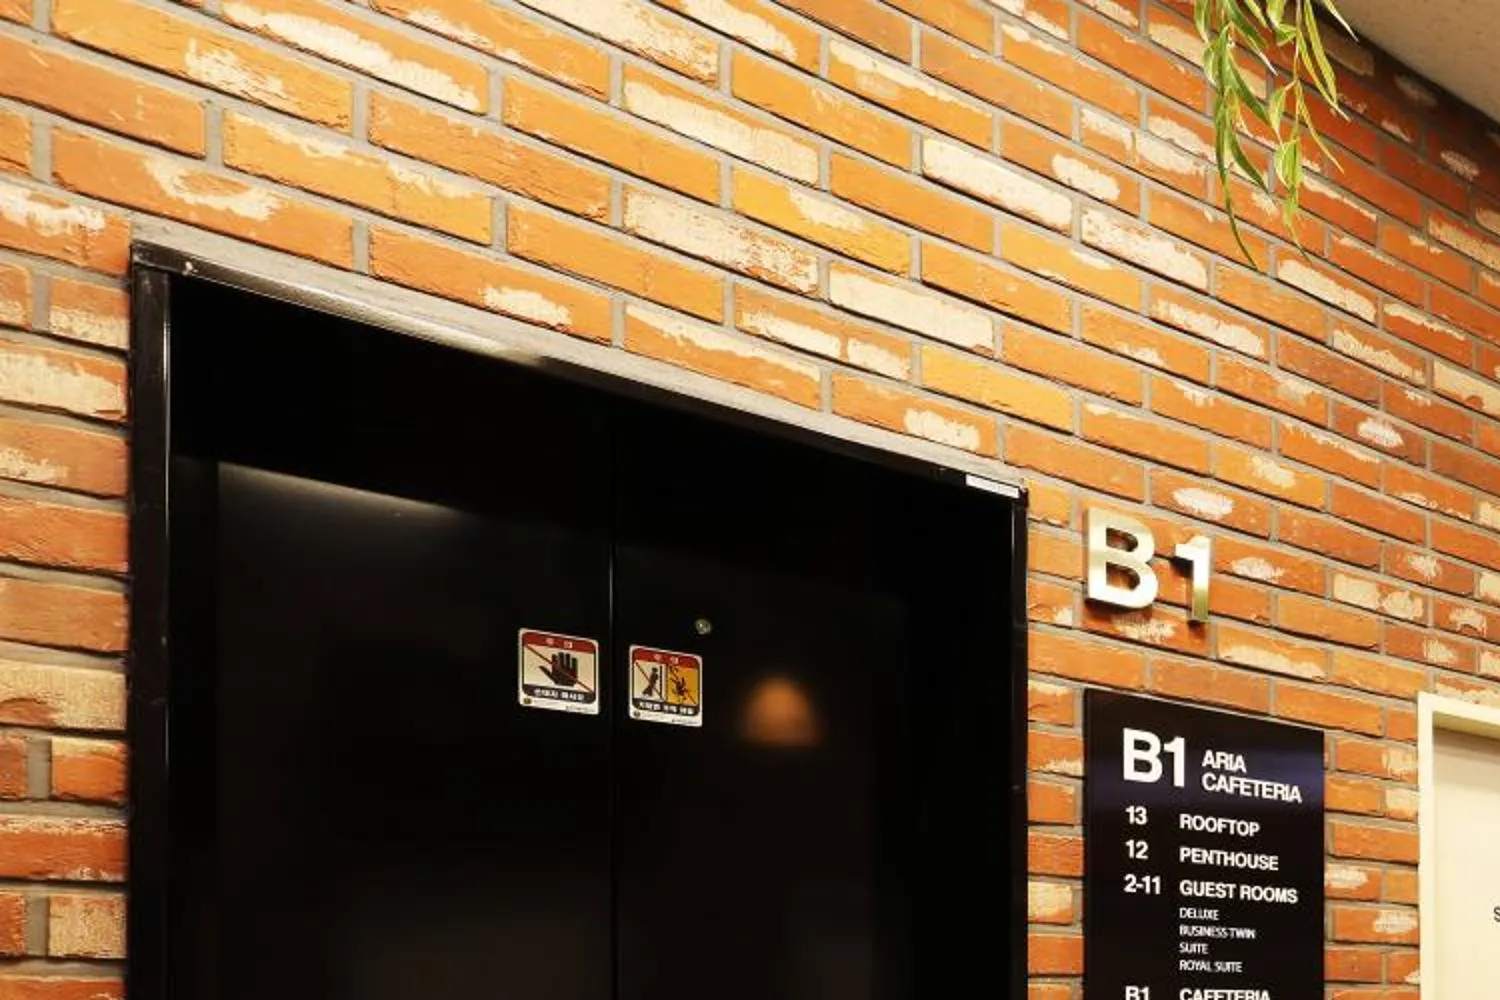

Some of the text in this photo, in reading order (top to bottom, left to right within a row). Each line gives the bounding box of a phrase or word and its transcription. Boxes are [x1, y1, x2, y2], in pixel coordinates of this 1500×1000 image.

[1087, 507, 1212, 621] B1
[1122, 727, 1186, 788] B1
[1202, 750, 1247, 774] ARIA
[1202, 772, 1303, 803] CAFETERIA
[1125, 805, 1261, 837] 13 ROOFTOP
[1125, 839, 1279, 871] 12 PENTHOUSE
[1123, 873, 1299, 904] 2-11 GUEST ROOMS
[1179, 907, 1220, 921] DELUXE
[1179, 924, 1229, 939] BUSINESS
[1179, 942, 1209, 955] SUITE
[1179, 959, 1243, 973] ROYAL SUITE
